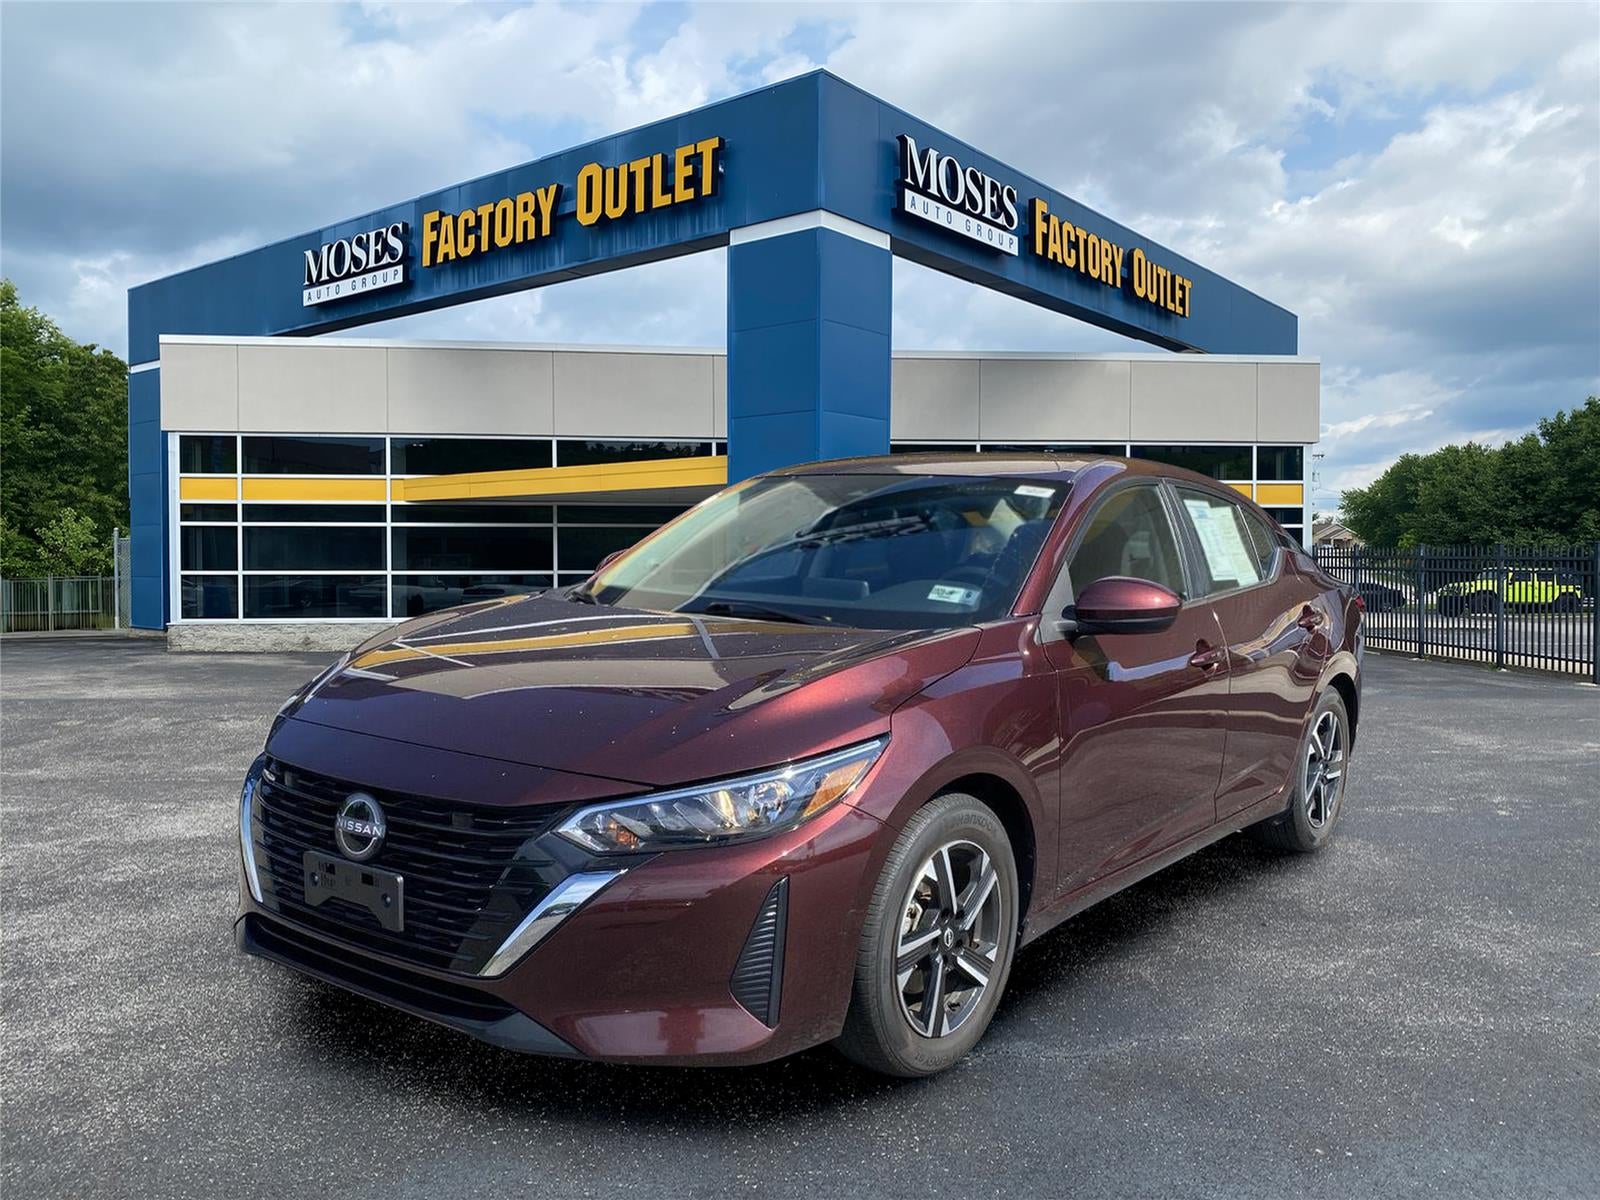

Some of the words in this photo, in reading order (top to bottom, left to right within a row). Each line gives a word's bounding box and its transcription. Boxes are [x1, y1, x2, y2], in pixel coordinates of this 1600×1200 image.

[421, 183, 560, 268] FACTORY
[576, 135, 720, 227] OUTLET
[902, 133, 1019, 231] MOSES
[302, 221, 404, 286] MOSES
[910, 194, 953, 225] AUTO
[965, 217, 1015, 250] GROUP
[307, 283, 341, 302] AUTO
[351, 268, 399, 291] GROUP
[1034, 196, 1124, 289] FACTORY
[1131, 247, 1193, 319] OUTLET
[337, 818, 382, 837] NISSAN
